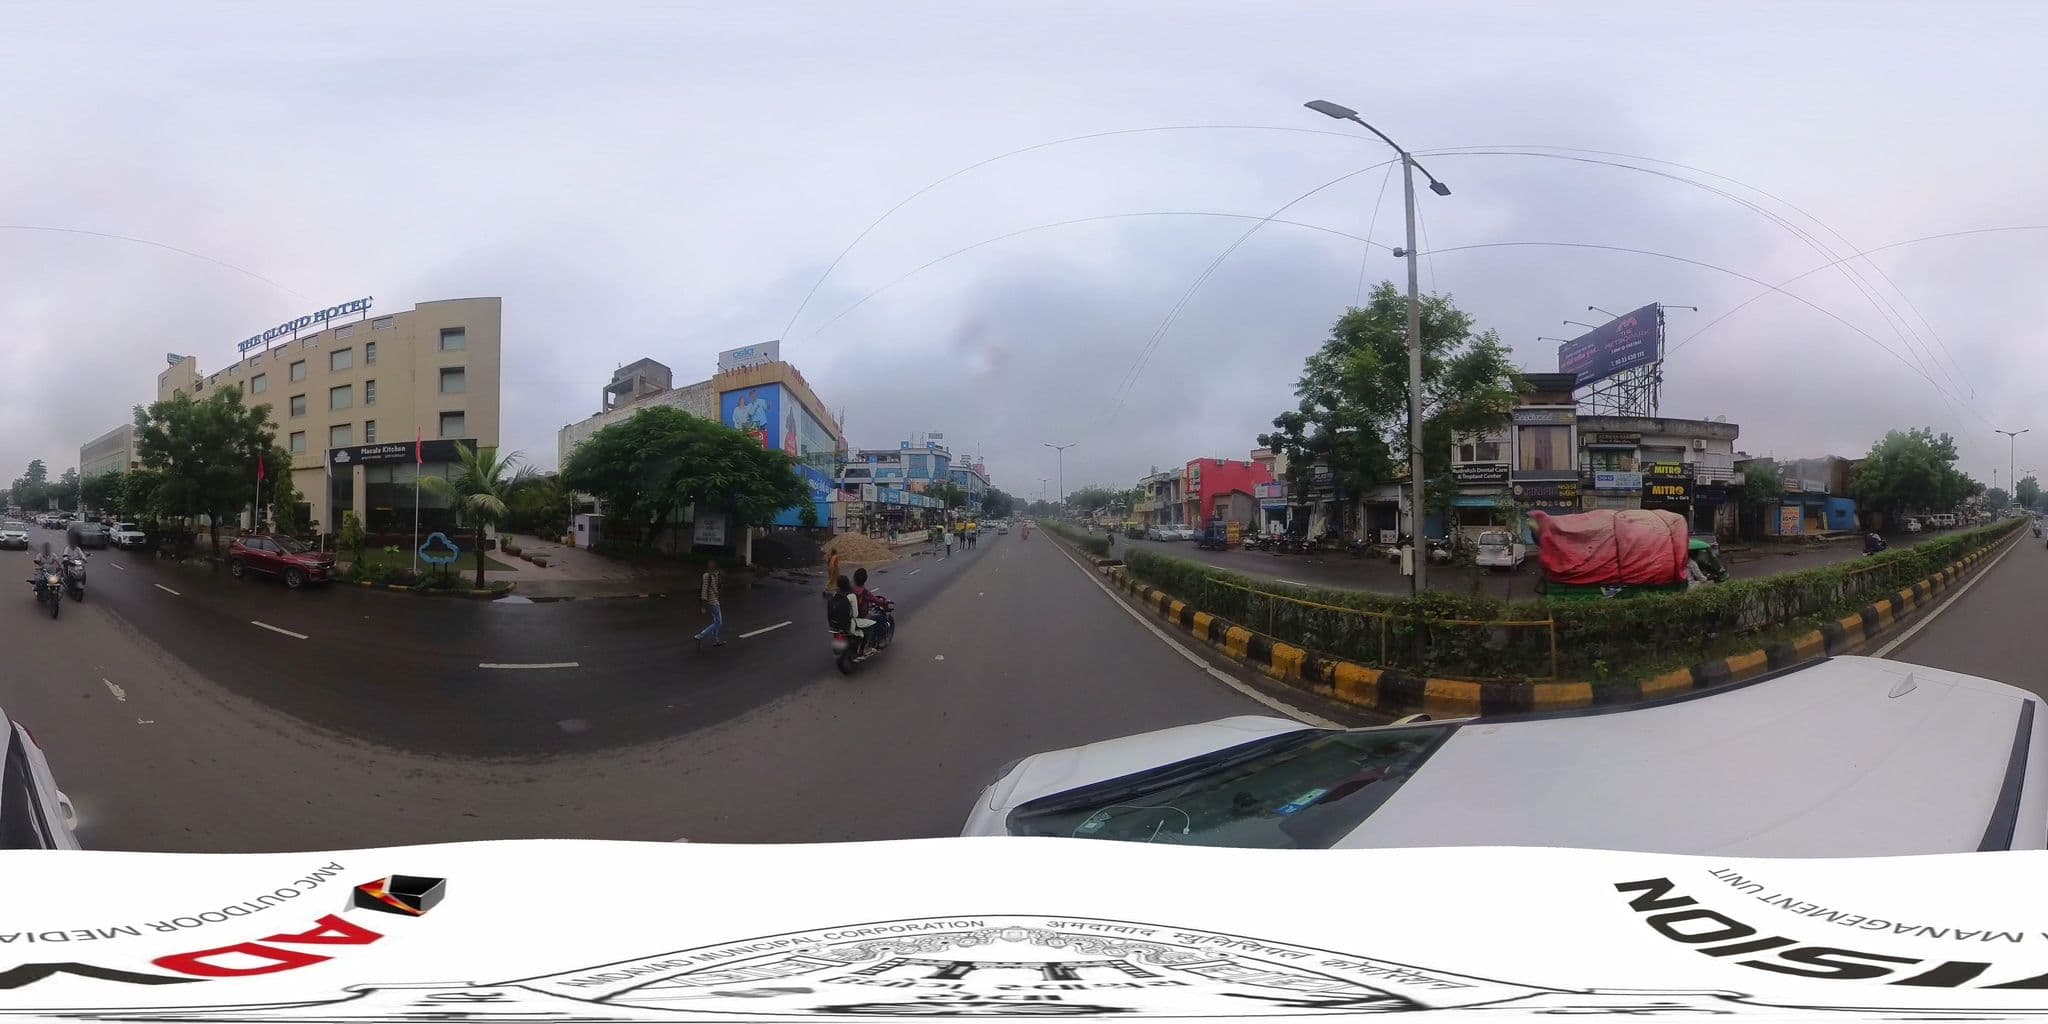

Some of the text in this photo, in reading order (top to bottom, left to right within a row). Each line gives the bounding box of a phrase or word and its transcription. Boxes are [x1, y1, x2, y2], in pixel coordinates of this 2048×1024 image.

[238, 298, 372, 352] THE CLOUD HOTEL
